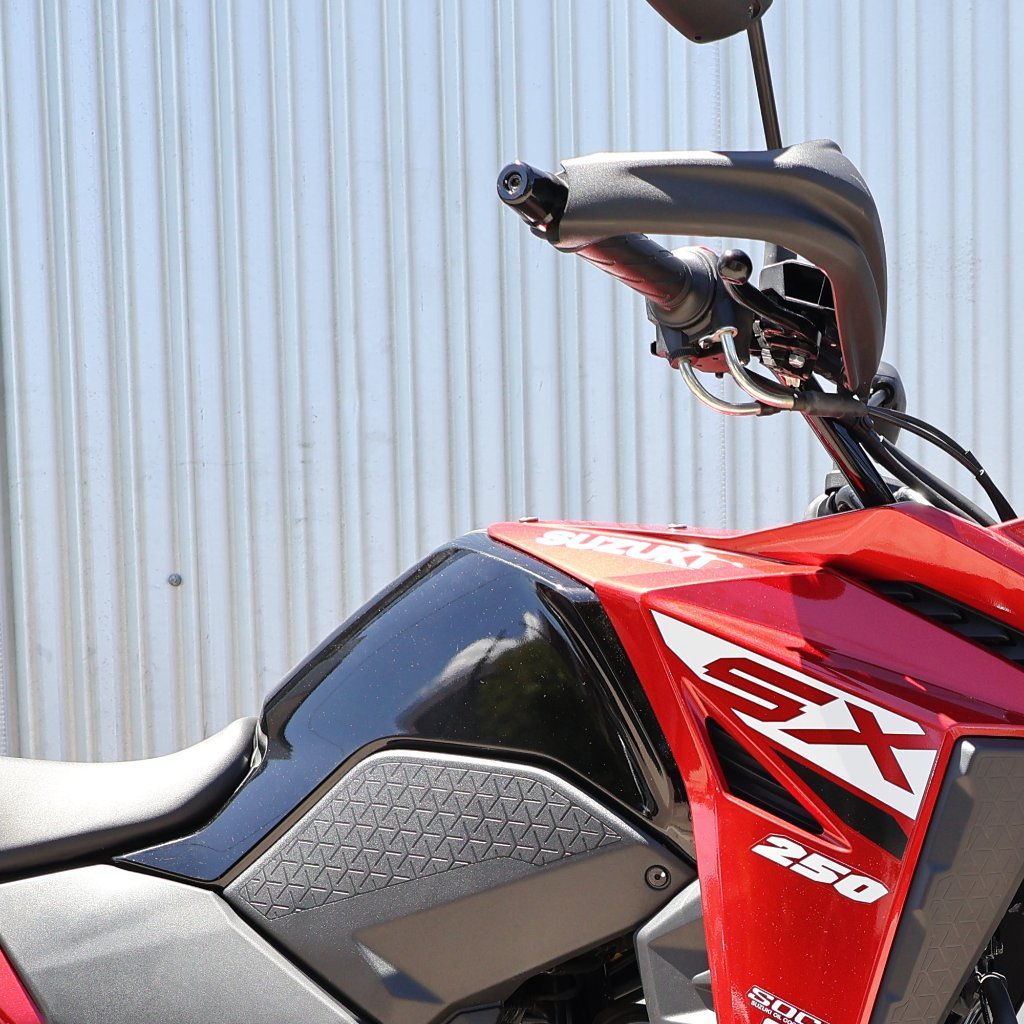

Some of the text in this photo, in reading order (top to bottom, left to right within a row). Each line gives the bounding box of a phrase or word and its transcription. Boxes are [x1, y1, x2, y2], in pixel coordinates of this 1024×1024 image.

[535, 529, 718, 570] SUZUKI
[702, 657, 926, 795] SX
[750, 833, 890, 904] 250
[750, 1000, 772, 1015] SUZUKI
[773, 1012, 782, 1021] OIL
